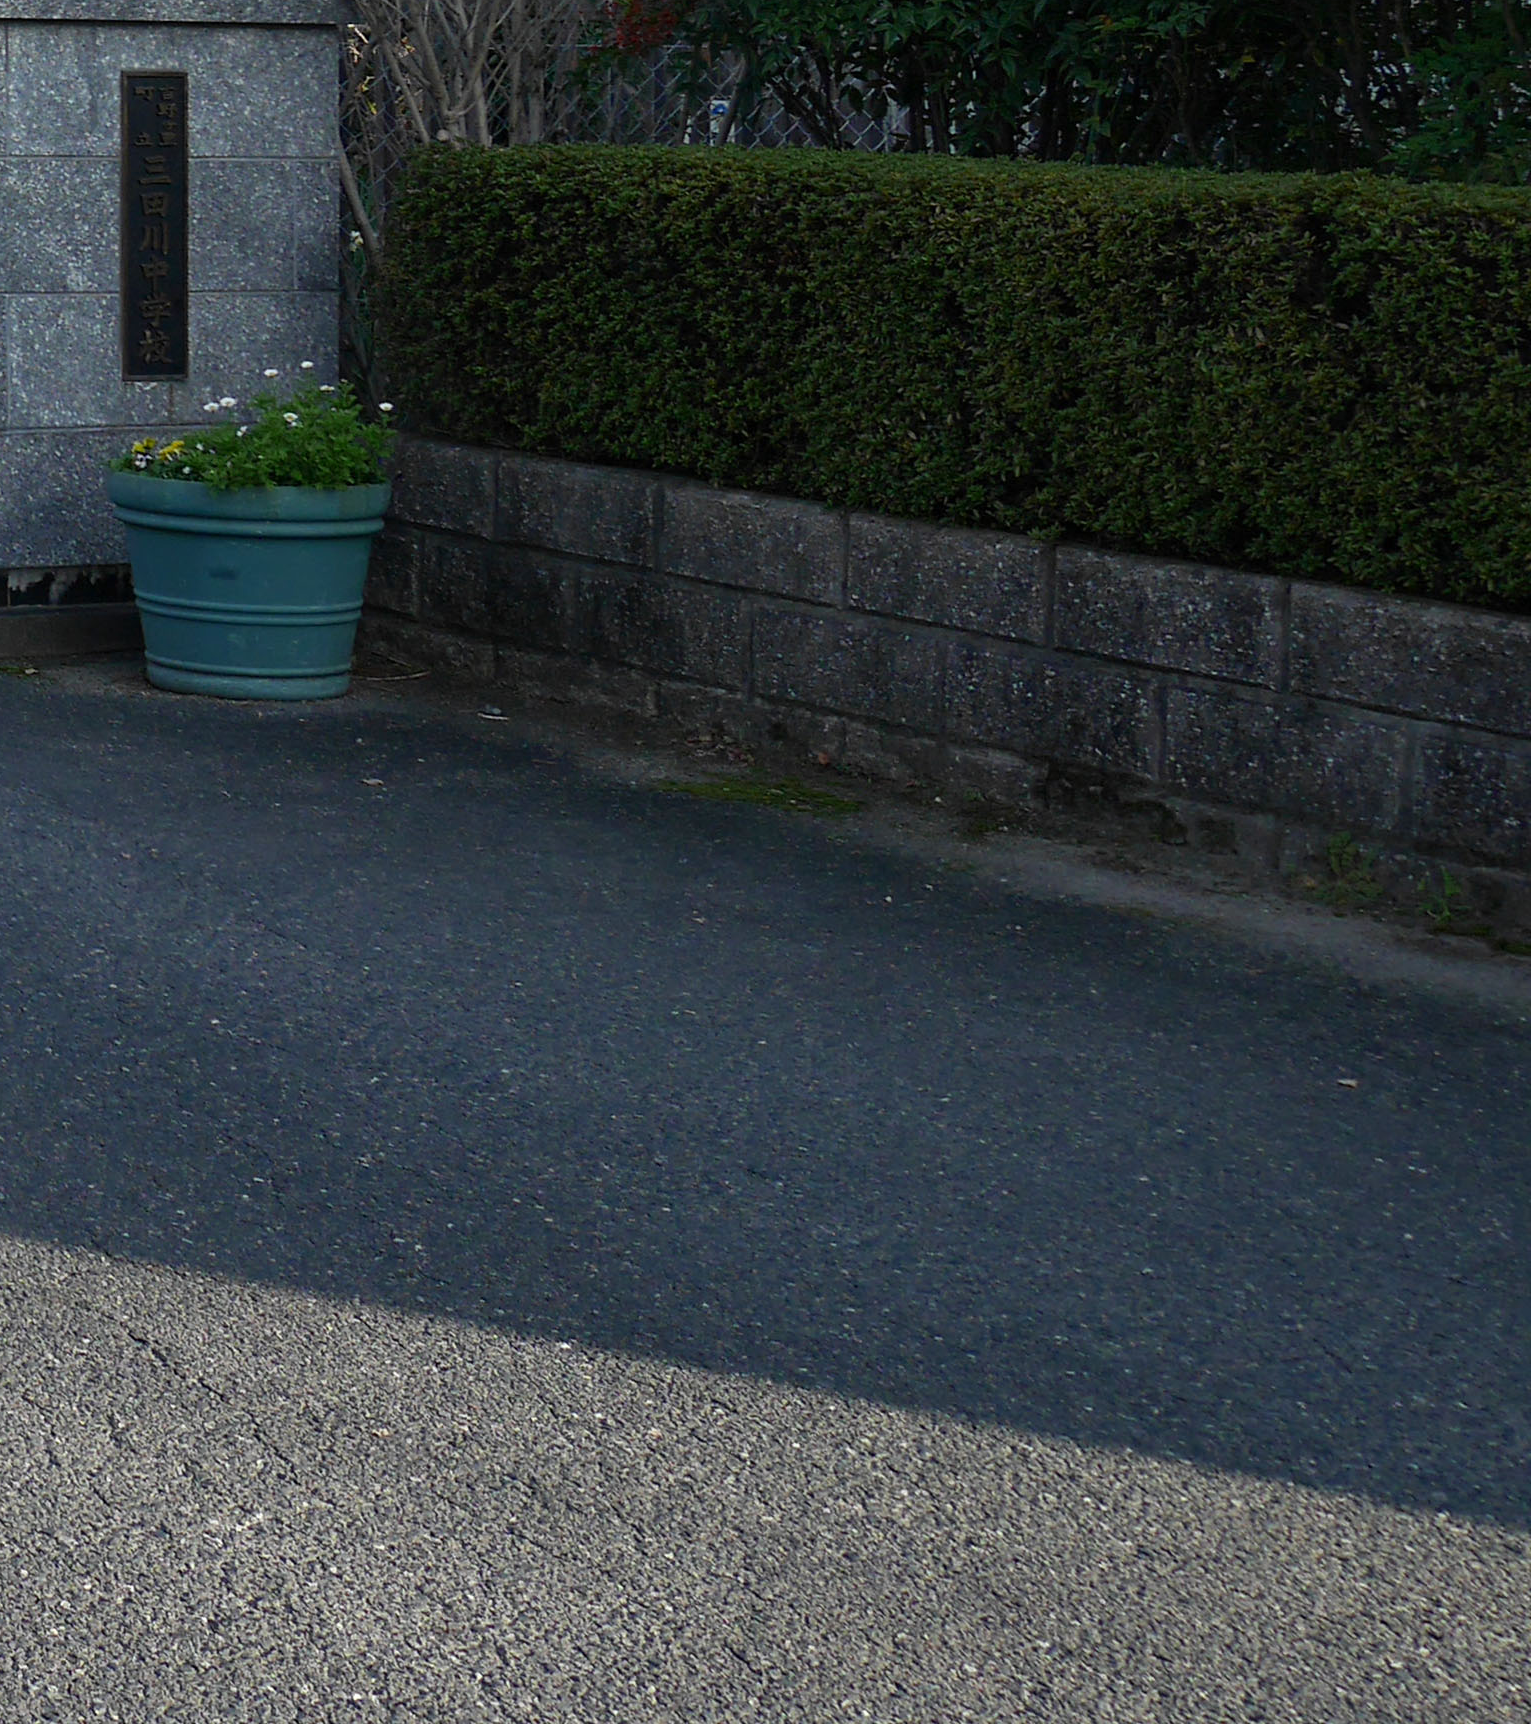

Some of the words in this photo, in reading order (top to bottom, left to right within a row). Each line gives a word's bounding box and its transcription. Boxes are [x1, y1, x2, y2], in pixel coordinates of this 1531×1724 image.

[138, 155, 173, 365] 三田川中学校
